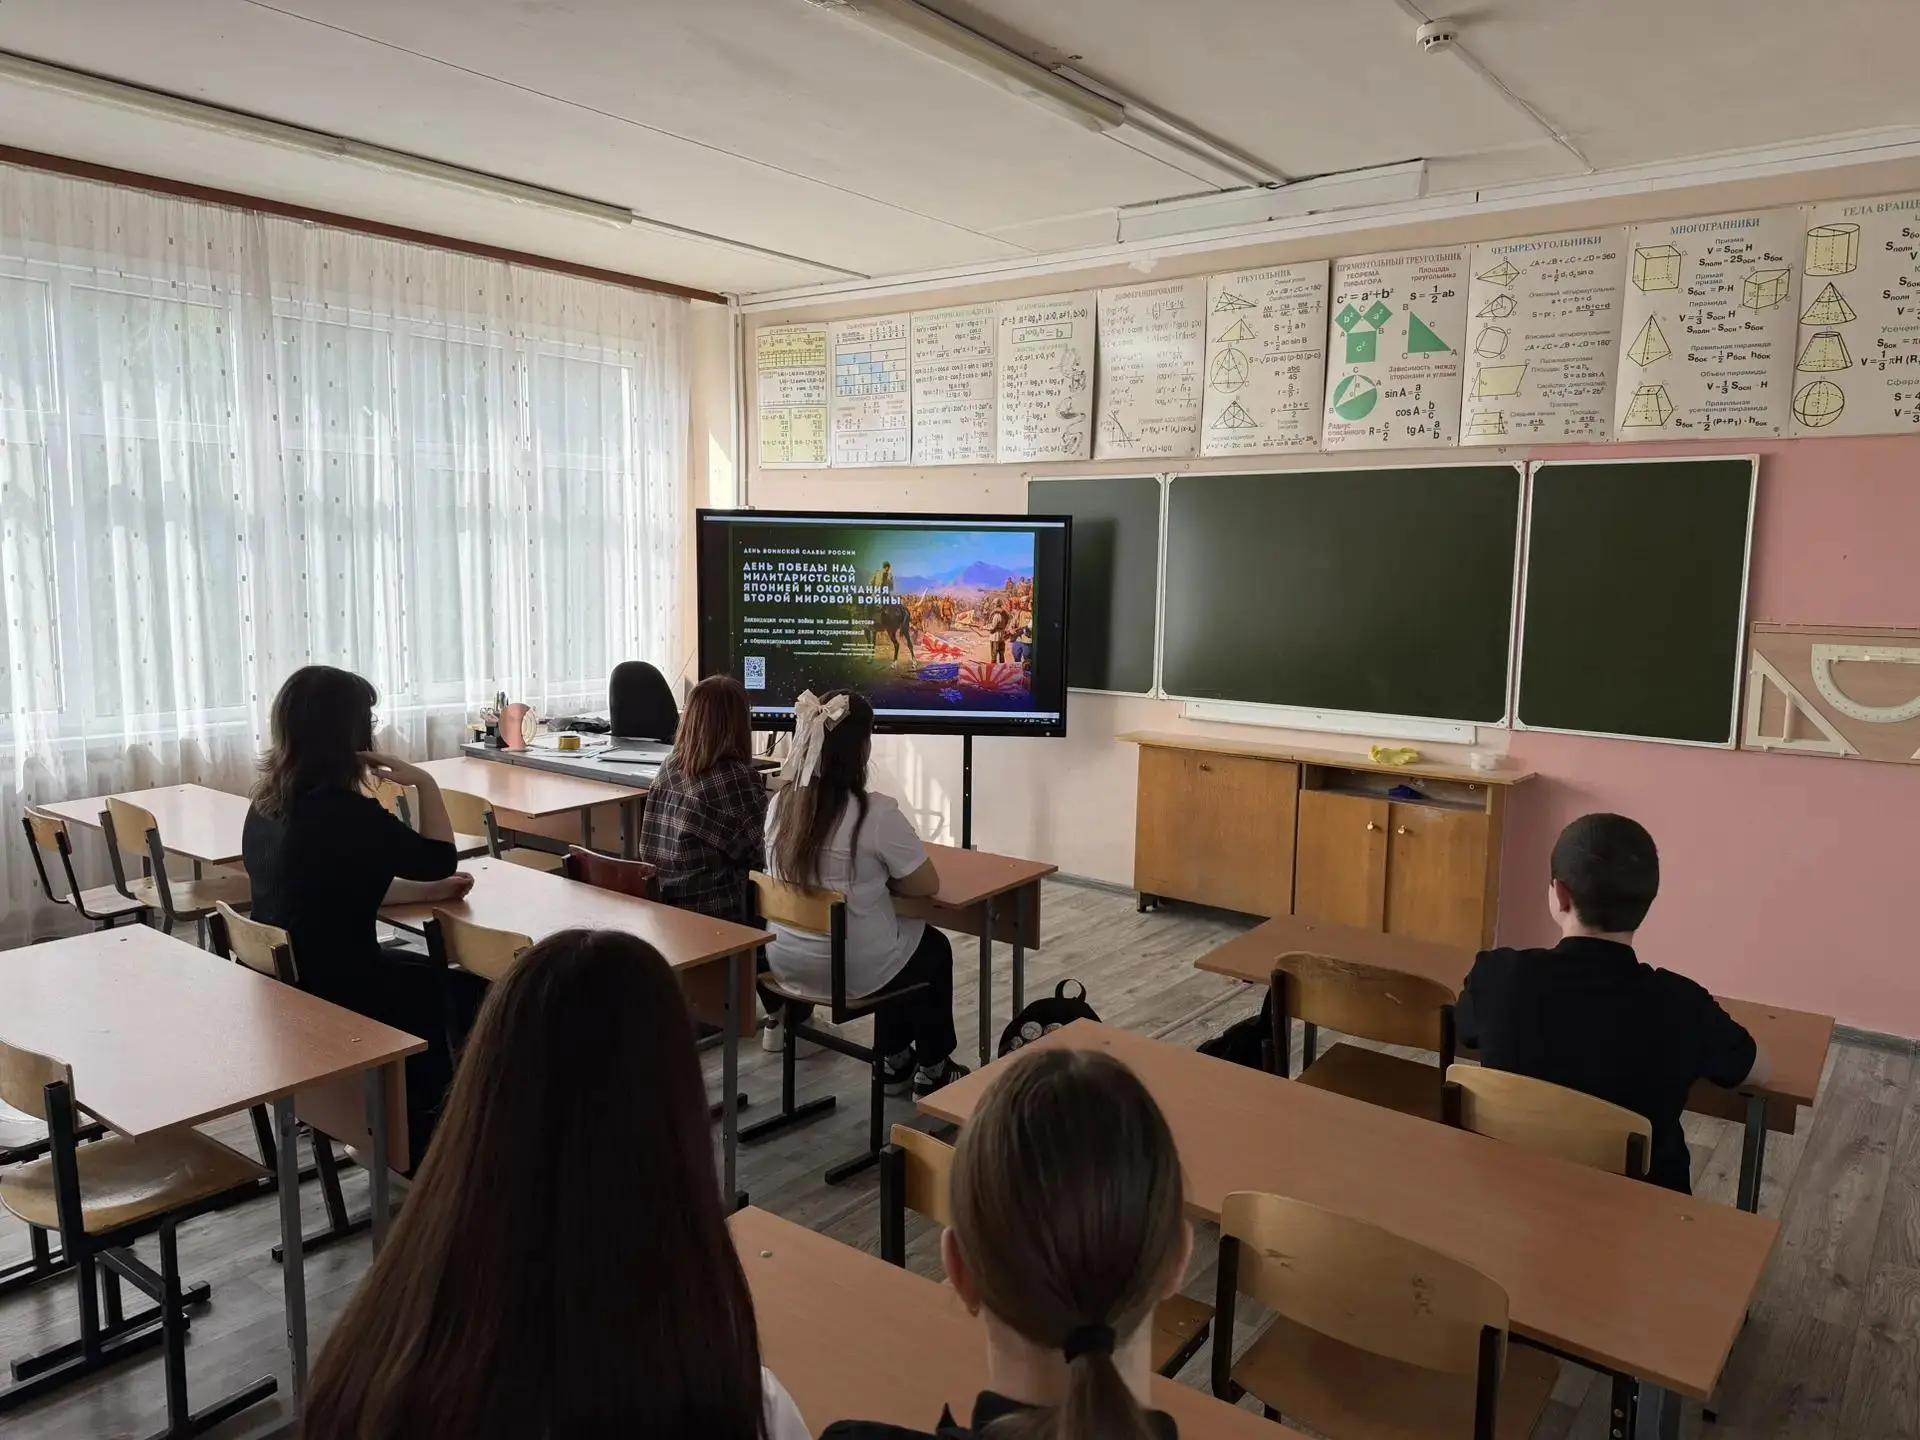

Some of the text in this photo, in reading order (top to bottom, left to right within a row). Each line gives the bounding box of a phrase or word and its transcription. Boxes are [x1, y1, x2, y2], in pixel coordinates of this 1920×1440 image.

[1841, 205, 1874, 217] ТЕЛА
[1671, 218, 1760, 235] МНОГОГРАННИКИ
[1491, 236, 1603, 255] ЧЕТЫРЕХУГОЛЬНИКИ
[1715, 237, 1744, 246] Призма
[1337, 252, 1463, 273] ПРЯМОУГОЛЬНЫЙ ТРЕУГОЛЬНИК
[1236, 270, 1292, 285] ТРЕУГОЛЬНИК
[1346, 270, 1379, 280] ТЕОРЕМА
[1343, 278, 1382, 288] ПИФАГОРА
[1689, 300, 1727, 309] Пирамида
[744, 547, 761, 555] ДЕНЬ
[763, 547, 800, 555] ВОИНСКОЙ
[743, 562, 856, 574] ДЕНЬ ПОБЕДЫ НАД
[743, 571, 856, 584] МИЛИТАРИСТСКОЙ
[743, 582, 890, 595] ЯПОНИЕЙ И ОКОНЧАНИЯ
[744, 592, 901, 605] ВТОРОЙ МИРОВОЙ ВОЙНЫ
